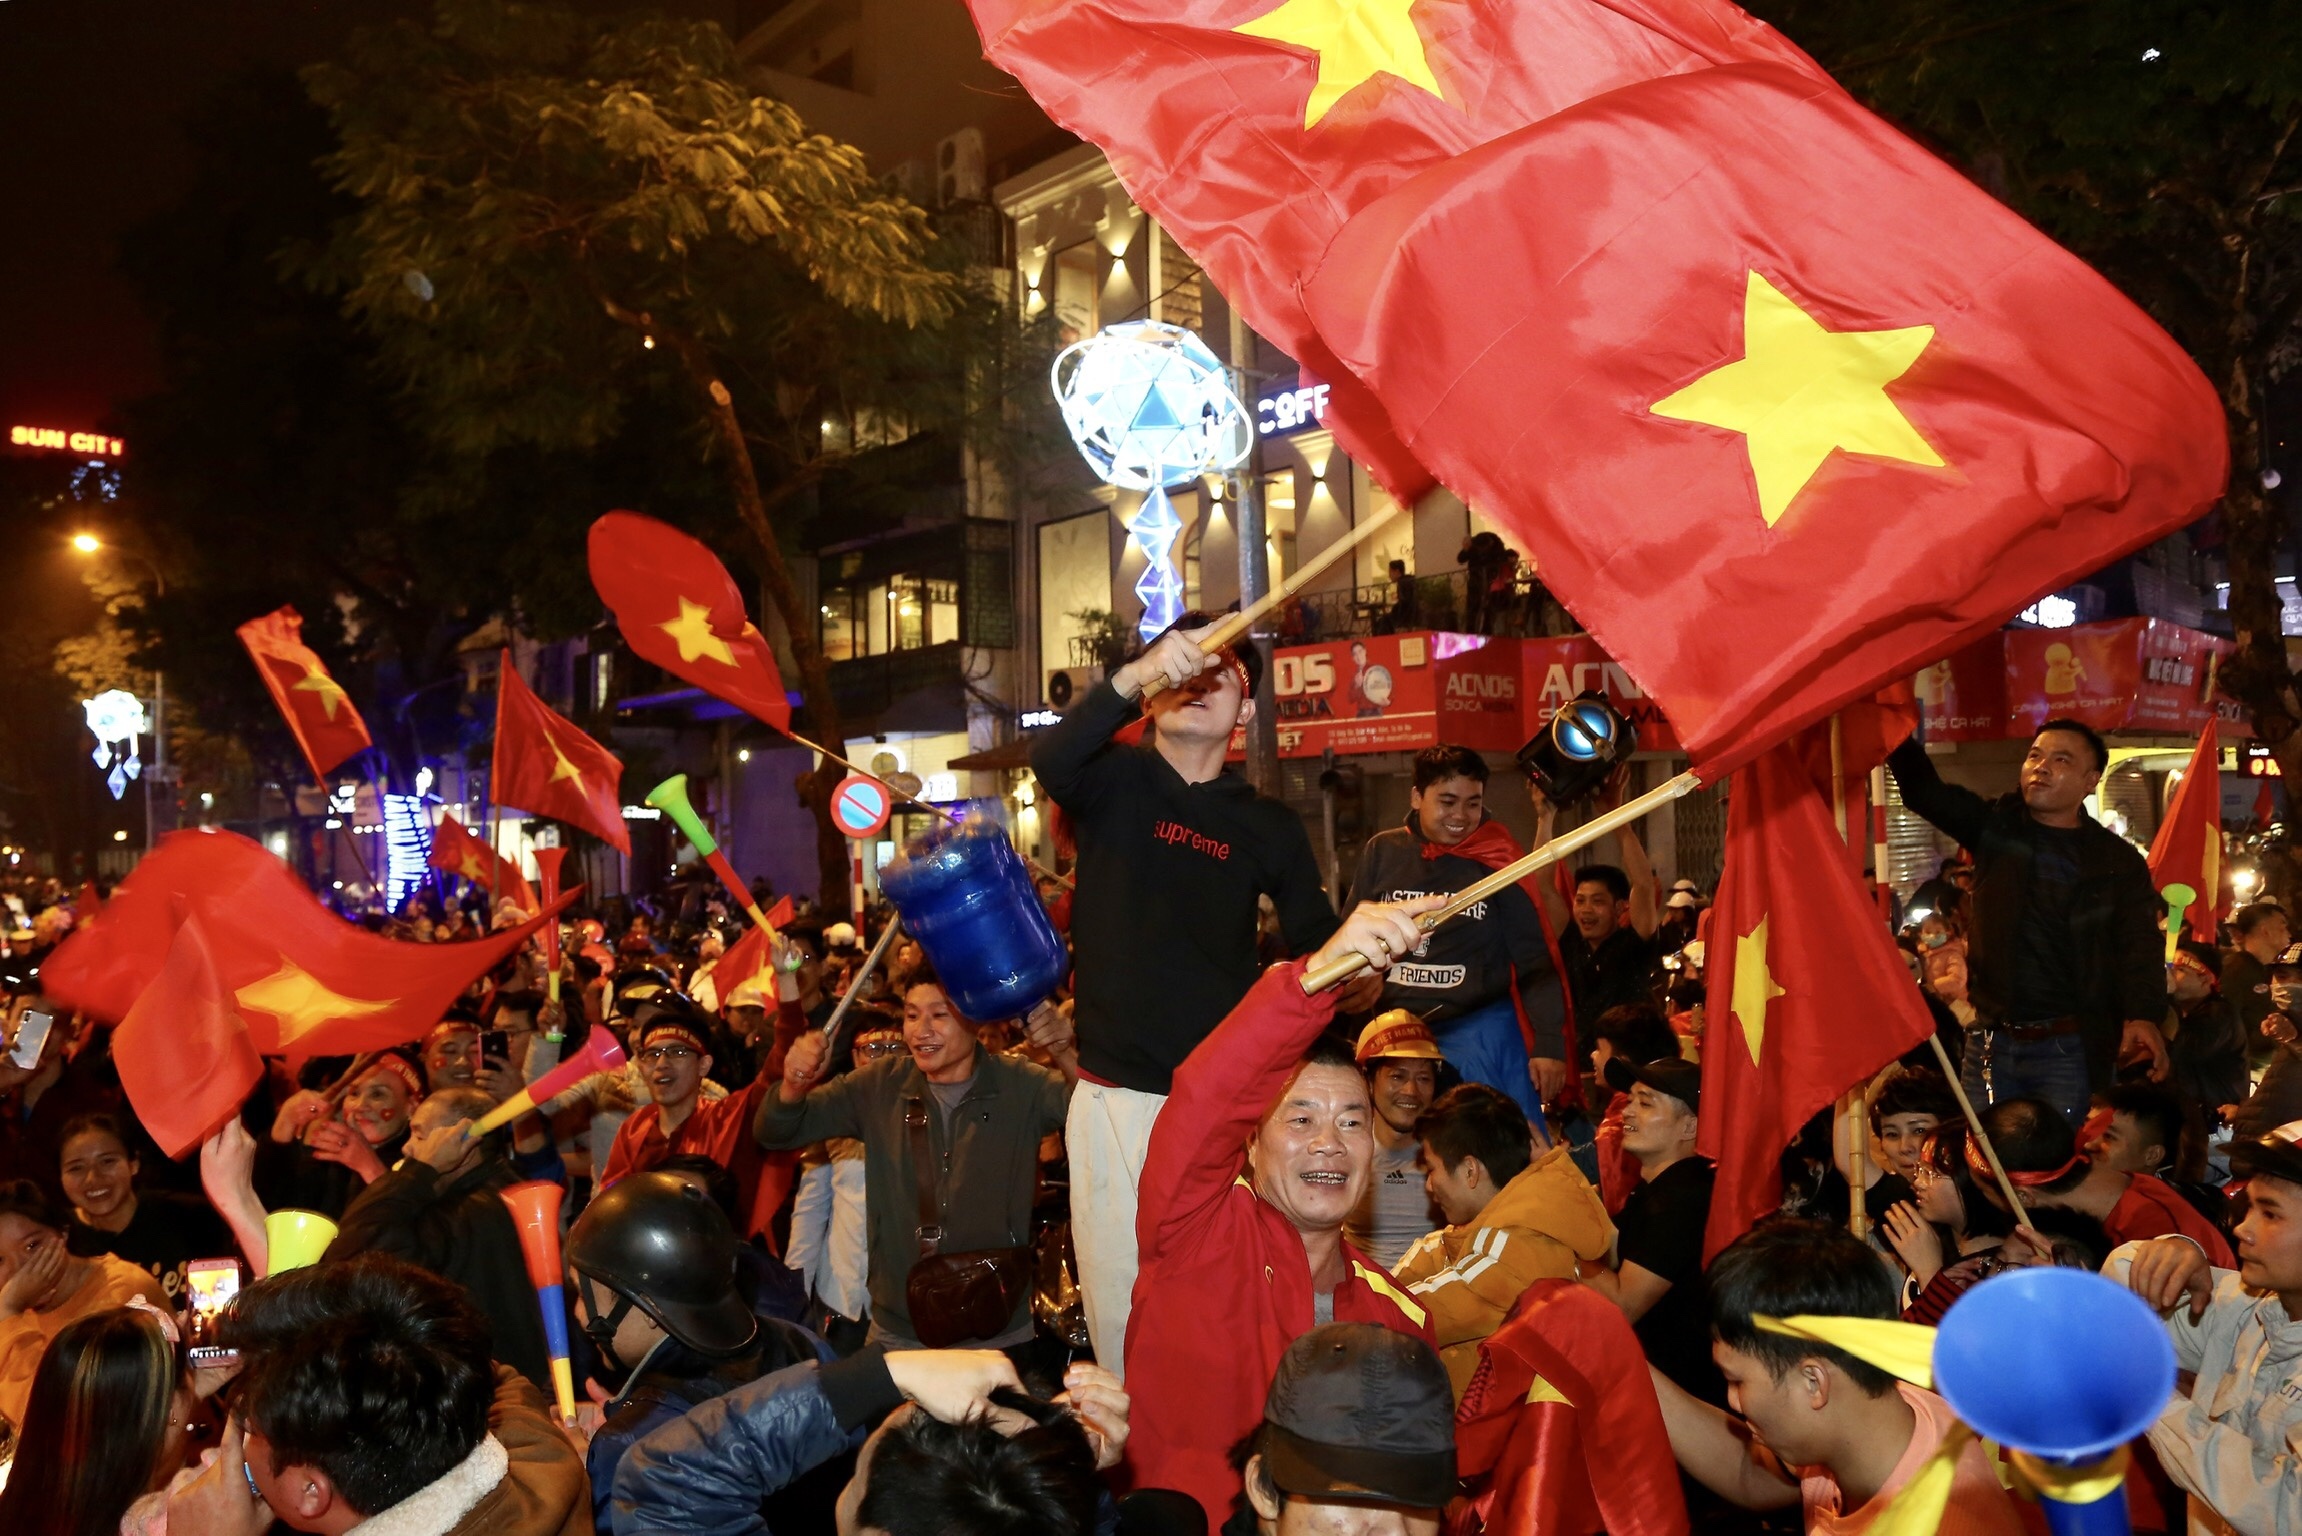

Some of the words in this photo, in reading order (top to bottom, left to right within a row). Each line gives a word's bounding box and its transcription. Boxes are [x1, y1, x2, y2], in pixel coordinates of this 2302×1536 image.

[11, 426, 66, 449] SUN
[70, 432, 124, 456] CITY
[1446, 672, 1515, 699] ACNOS
[1400, 966, 1462, 984] FRIENDS
